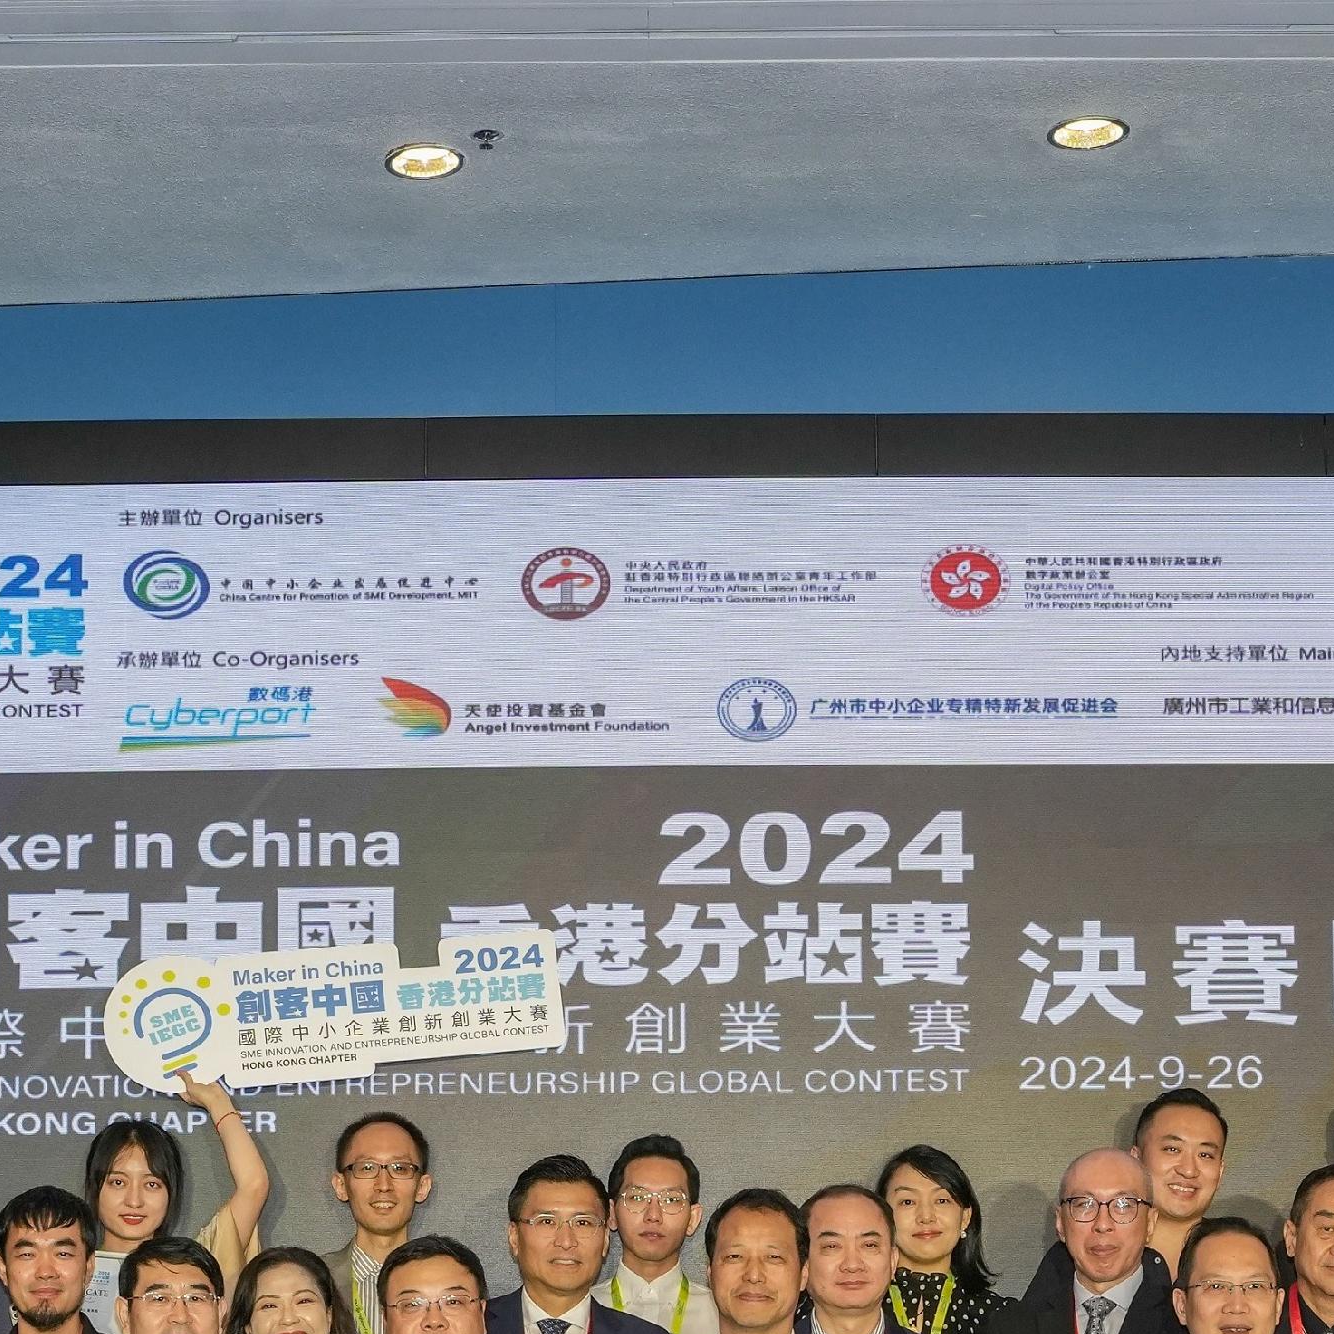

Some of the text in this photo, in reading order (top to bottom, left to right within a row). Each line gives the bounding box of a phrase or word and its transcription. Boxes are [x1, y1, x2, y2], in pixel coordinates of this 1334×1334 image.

[118, 509, 323, 528] 主辦單位 Organisers
[117, 649, 360, 670] 承辦單位 Co-Organisers
[247, 687, 314, 702] 數碼港
[810, 697, 1117, 714] 广州市中小企业专精特新发展促进会
[125, 698, 317, 737] Cyberport
[465, 703, 606, 718] 天使投資基金會
[465, 721, 669, 735] Angel Investment Foundation
[115, 819, 175, 869] in
[197, 818, 401, 871] China
[658, 811, 974, 885] 2024
[454, 944, 544, 974] 2024
[1018, 919, 1298, 1026] 決賽
[233, 960, 384, 986] Maker in China
[236, 973, 545, 1024] 創客中國 香港分站賽
[149, 1004, 195, 1029] SME
[238, 1004, 549, 1046] 國際中小企業創新創業大賽
[149, 1018, 202, 1046] IEGC
[240, 1024, 549, 1059] SME INNOVATION AND ENTREPRENEURSHIP GLOBAL CONTEST
[242, 1053, 357, 1070] HONG KONG CHAPTER
[1018, 1055, 1264, 1090] 2024-9-26
[652, 1070, 793, 1095] GLOBAL
[804, 1068, 970, 1093] CONTEST
